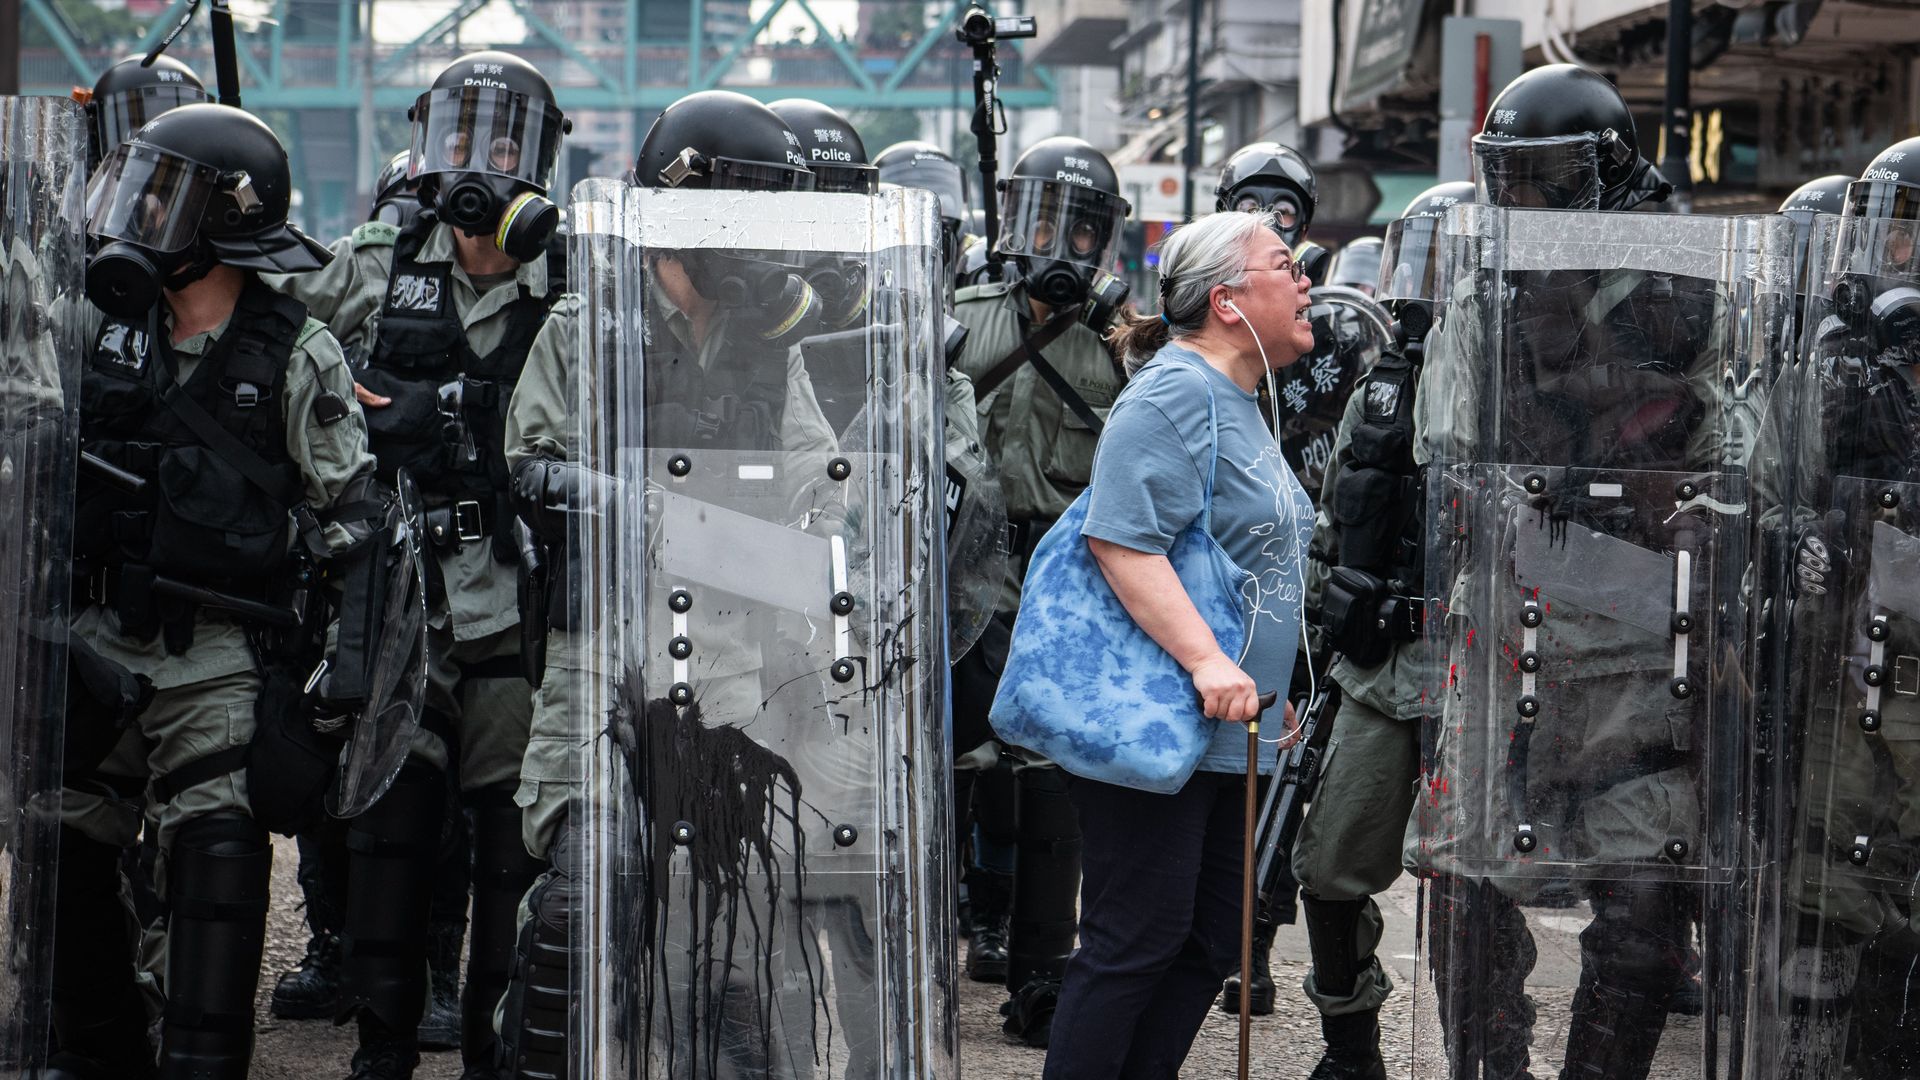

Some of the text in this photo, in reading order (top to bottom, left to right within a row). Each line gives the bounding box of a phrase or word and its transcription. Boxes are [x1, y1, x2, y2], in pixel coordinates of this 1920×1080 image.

[473, 64, 504, 75] 警察
[1493, 109, 1518, 125] 警察
[813, 129, 843, 143] 警察
[811, 148, 851, 162] Police
[1064, 156, 1089, 171] 警察
[1056, 170, 1093, 187] Police
[1867, 168, 1899, 181] Police
[1282, 353, 1342, 413] 警察
